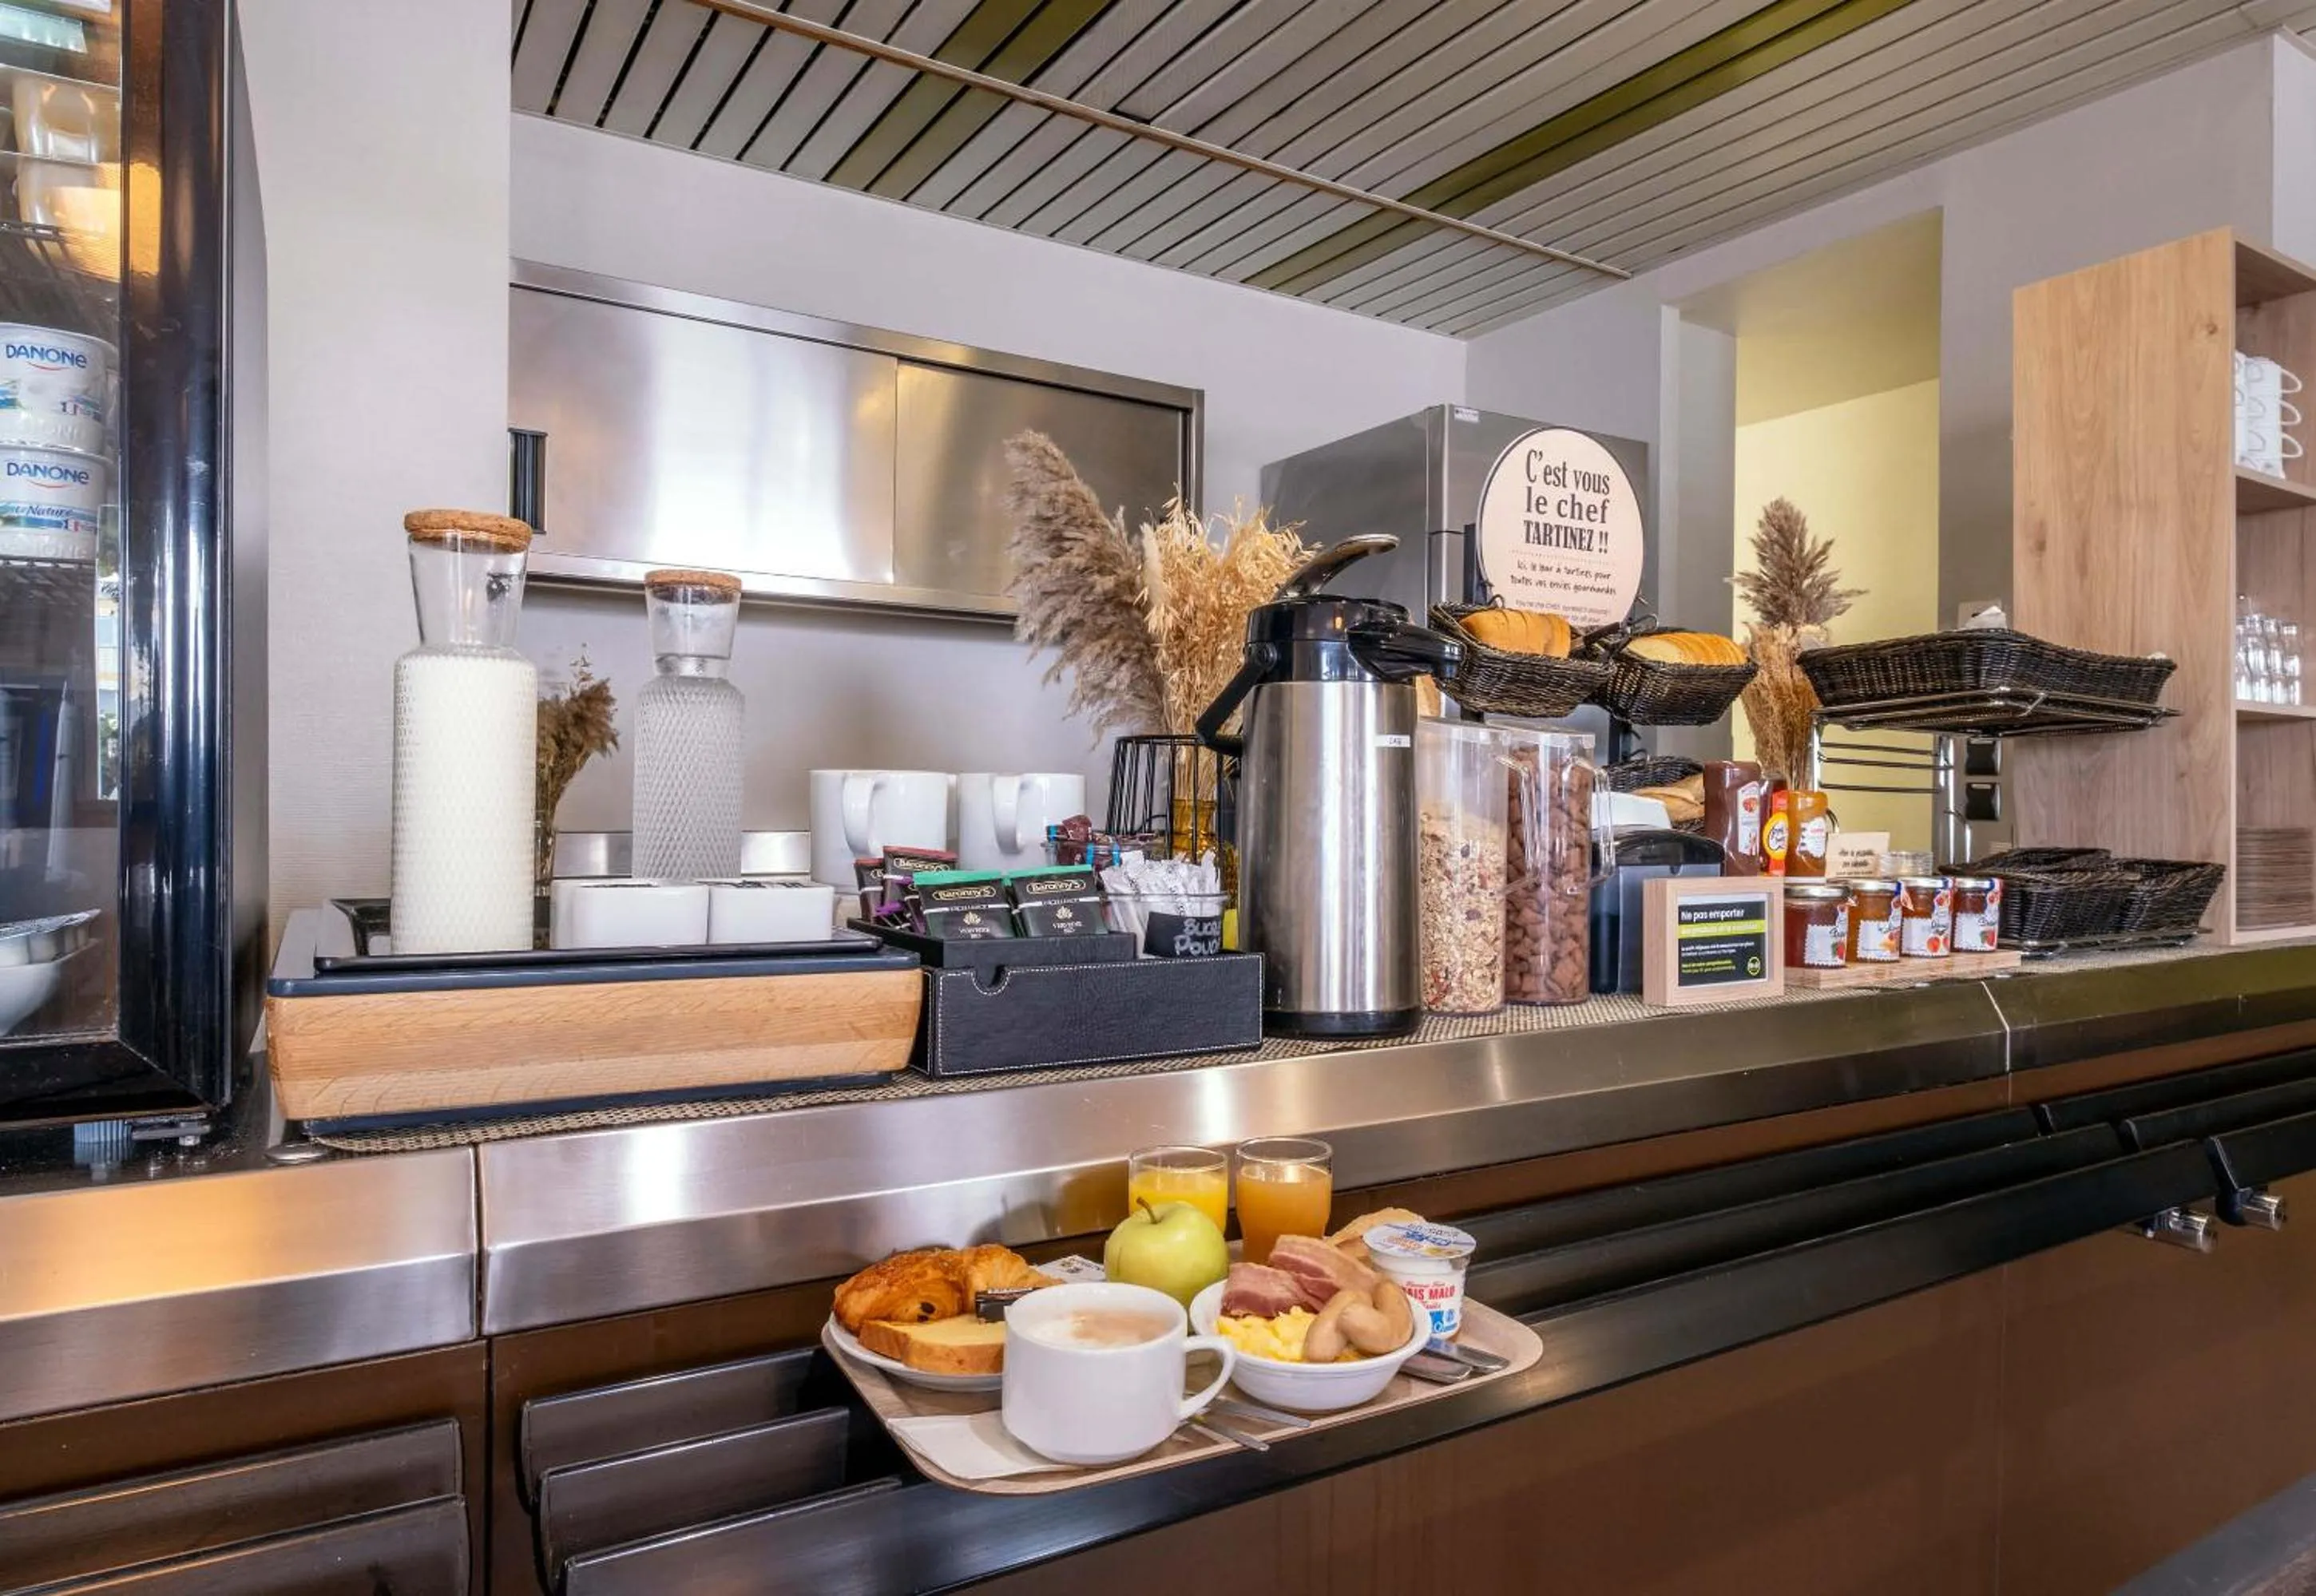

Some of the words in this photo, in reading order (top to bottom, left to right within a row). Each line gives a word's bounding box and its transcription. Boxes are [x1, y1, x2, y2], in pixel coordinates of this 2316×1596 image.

[6, 344, 87, 368] DANONE
[7, 461, 89, 485] DANONE
[1573, 469, 1610, 495] vous
[1526, 485, 1548, 515] le
[1557, 493, 1610, 524] chef
[1524, 520, 1594, 552] TARTINEZ
[1599, 531, 1608, 554] !!
[1681, 910, 1692, 921] Ne
[1693, 912, 1708, 923] pas
[1709, 909, 1745, 921] emporter
[1429, 1284, 1456, 1301] MALO
